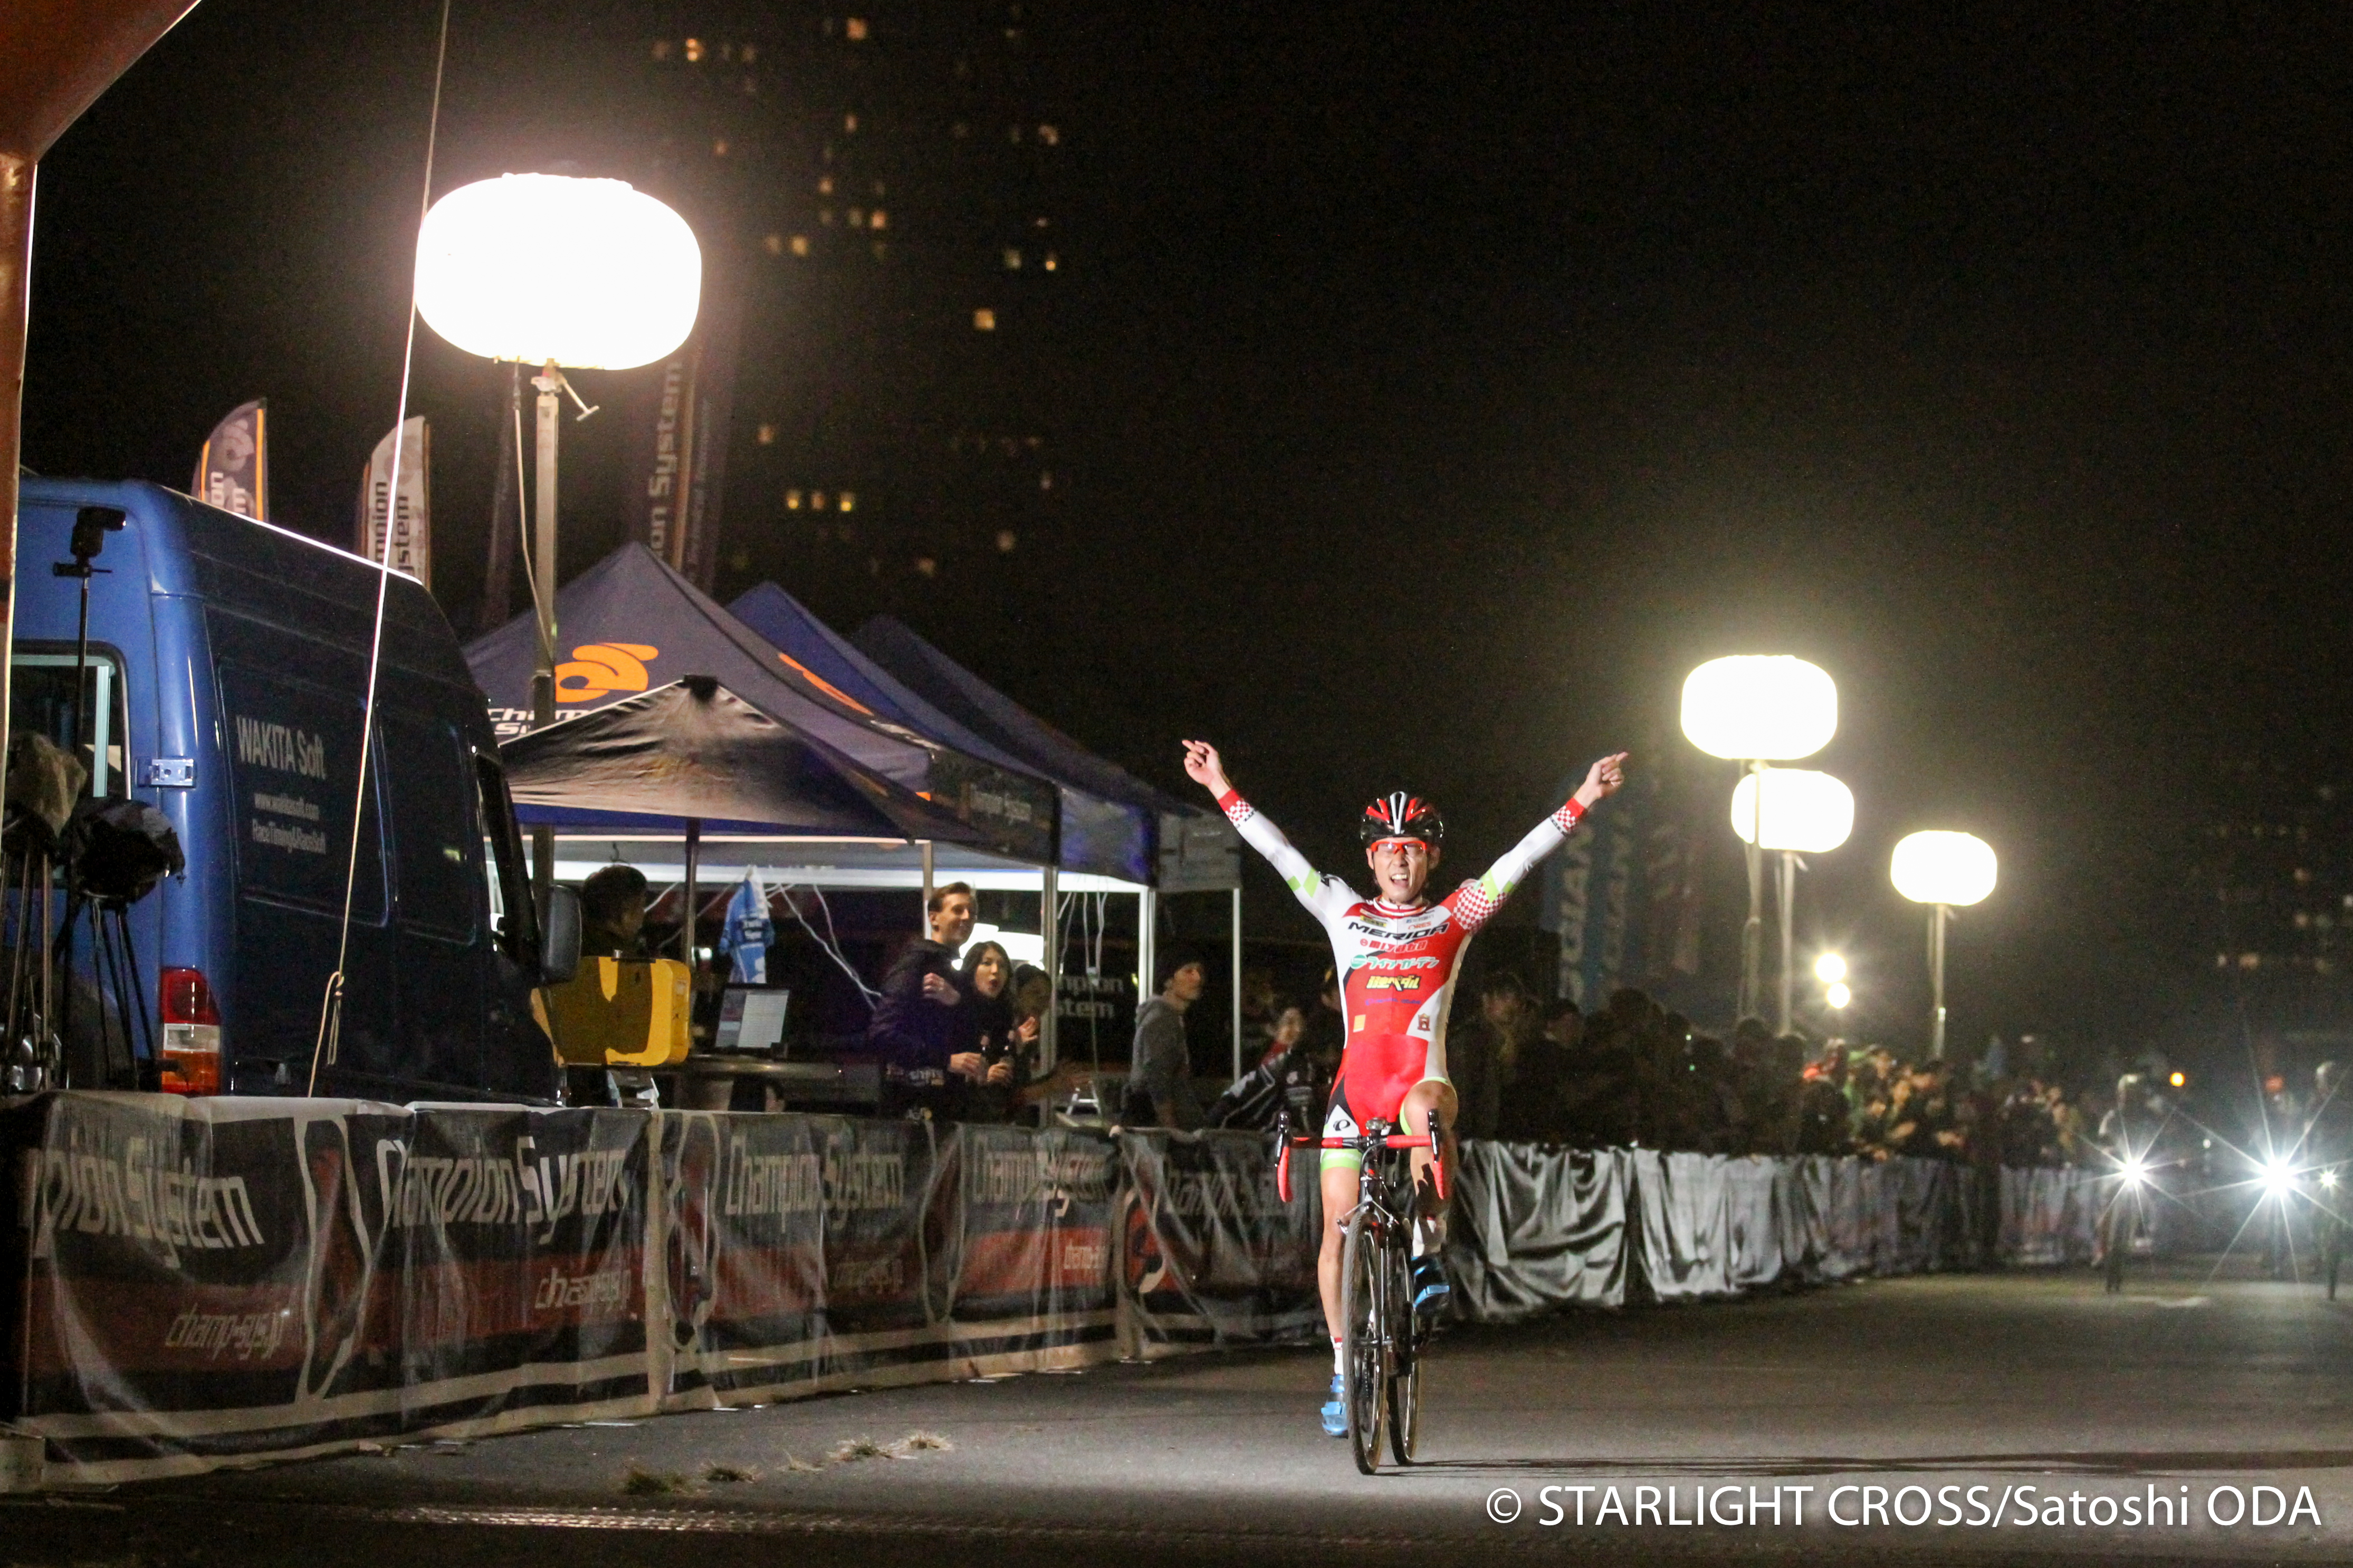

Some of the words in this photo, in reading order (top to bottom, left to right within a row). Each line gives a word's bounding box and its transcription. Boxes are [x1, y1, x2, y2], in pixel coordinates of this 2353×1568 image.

[236, 714, 297, 773] WAKITA
[1348, 921, 1450, 940] MERIDA
[126, 1137, 265, 1268] System
